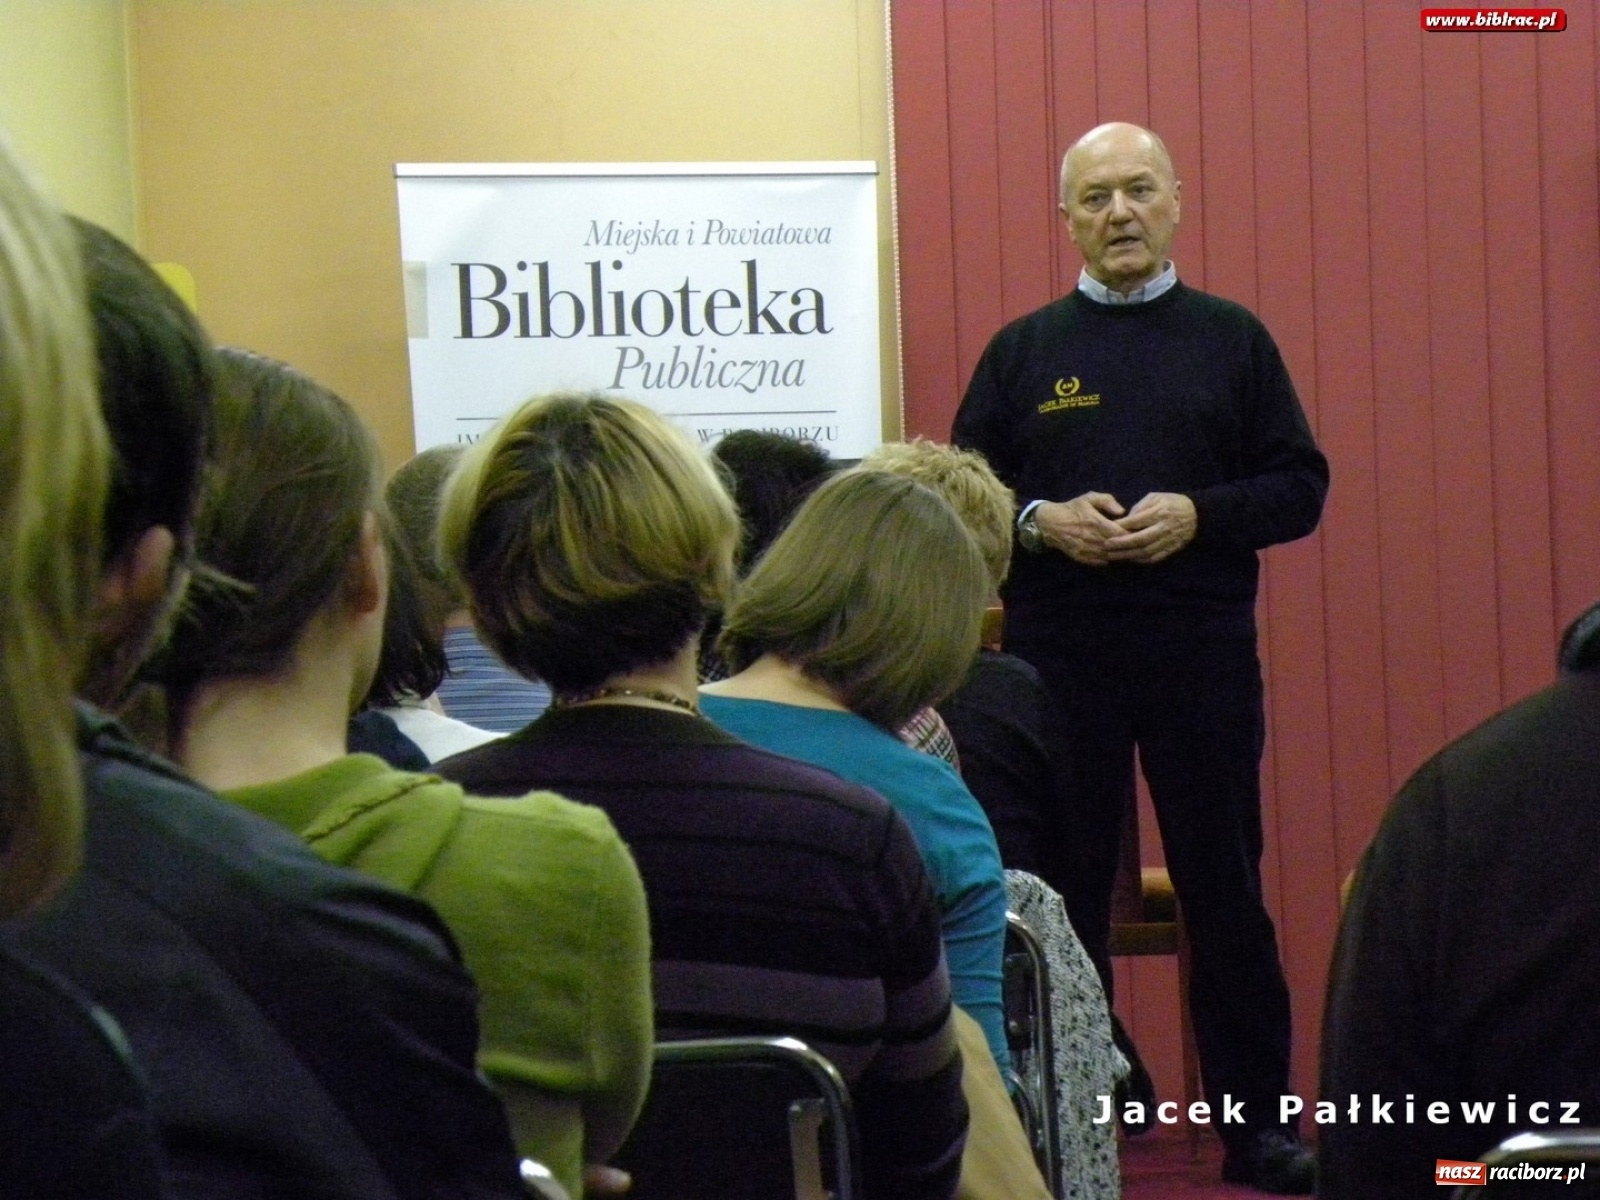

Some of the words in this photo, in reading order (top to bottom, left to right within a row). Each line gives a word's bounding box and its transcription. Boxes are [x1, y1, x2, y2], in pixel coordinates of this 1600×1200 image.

[583, 219, 679, 255] Miejska
[686, 219, 696, 247] i
[702, 218, 832, 246] Powiatowa
[451, 259, 834, 339] Biblioteka
[606, 345, 806, 394] Publiczna
